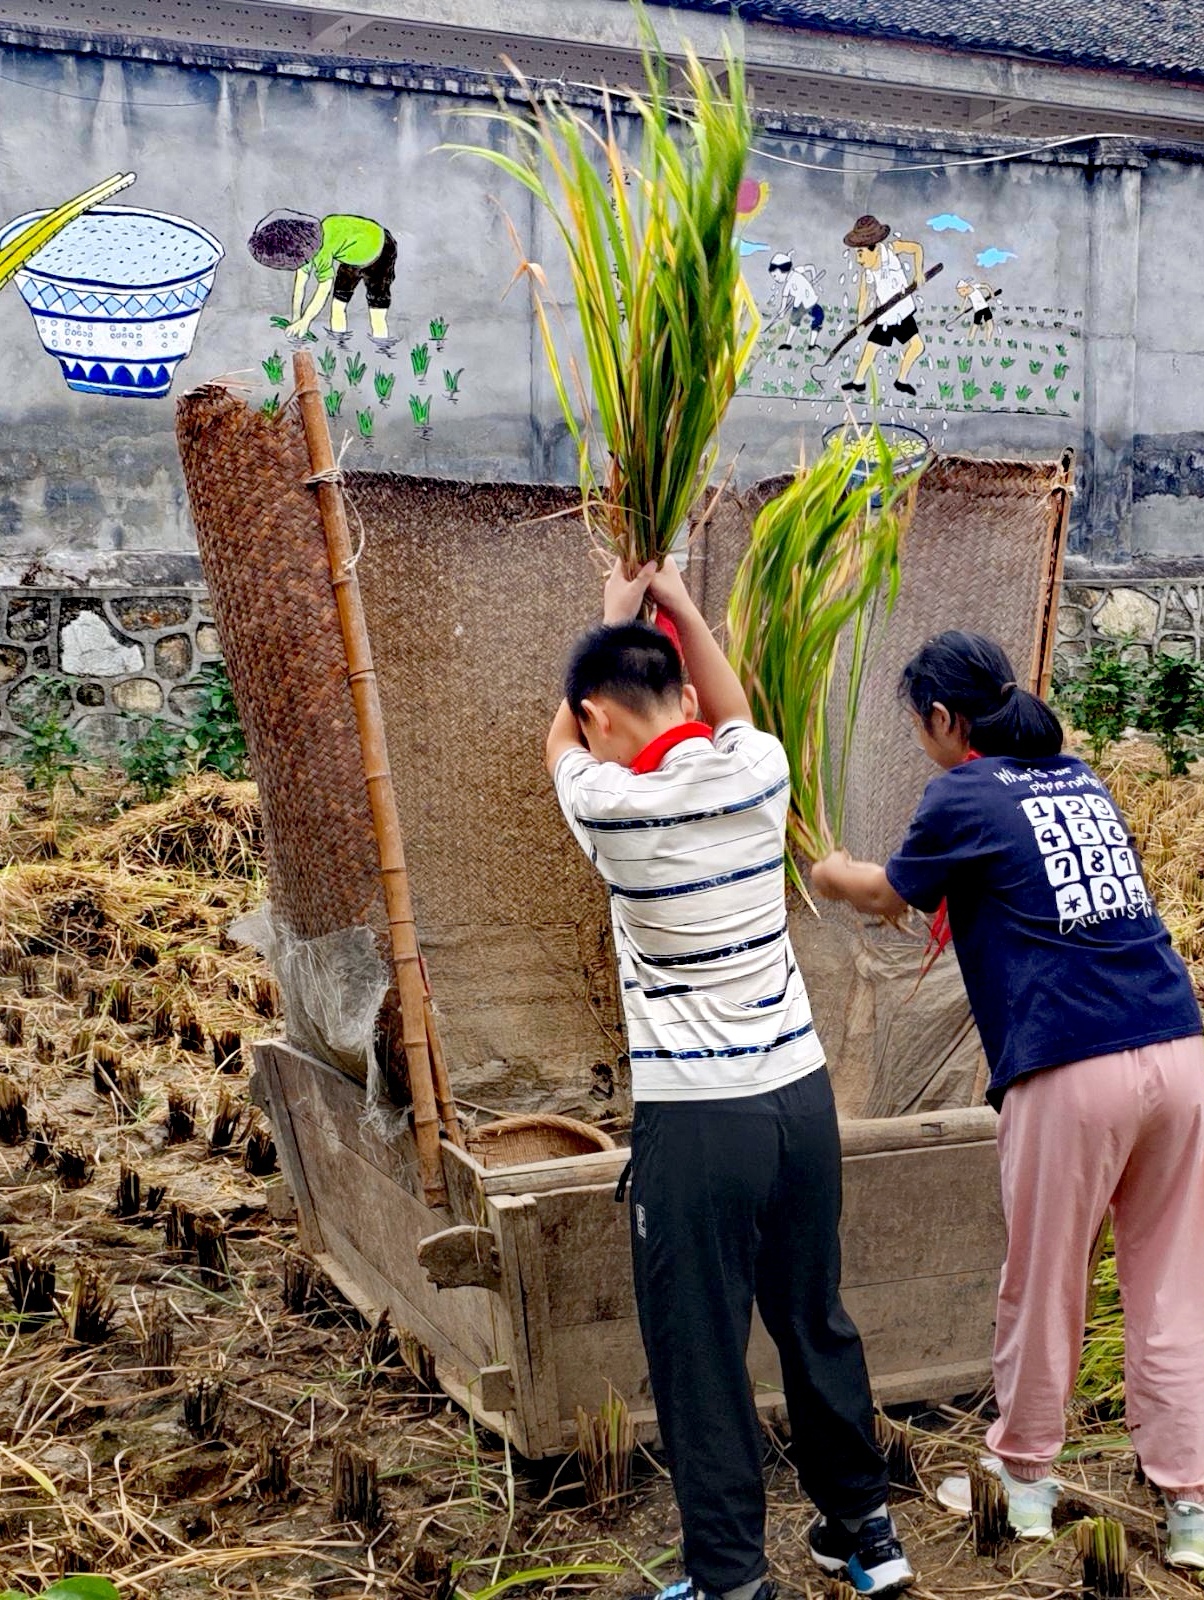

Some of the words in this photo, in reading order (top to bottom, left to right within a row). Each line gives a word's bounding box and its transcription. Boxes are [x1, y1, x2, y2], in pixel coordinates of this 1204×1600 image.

[1031, 801, 1049, 819] 1
[1065, 800, 1084, 815] 2
[1093, 798, 1110, 816] 3
[1040, 828, 1062, 848] 4
[1077, 823, 1094, 840] 5
[1109, 826, 1124, 842] 6
[1054, 857, 1071, 879] 7
[1090, 849, 1105, 873] 8
[1119, 851, 1132, 871] 9
[1100, 882, 1117, 906] 0
